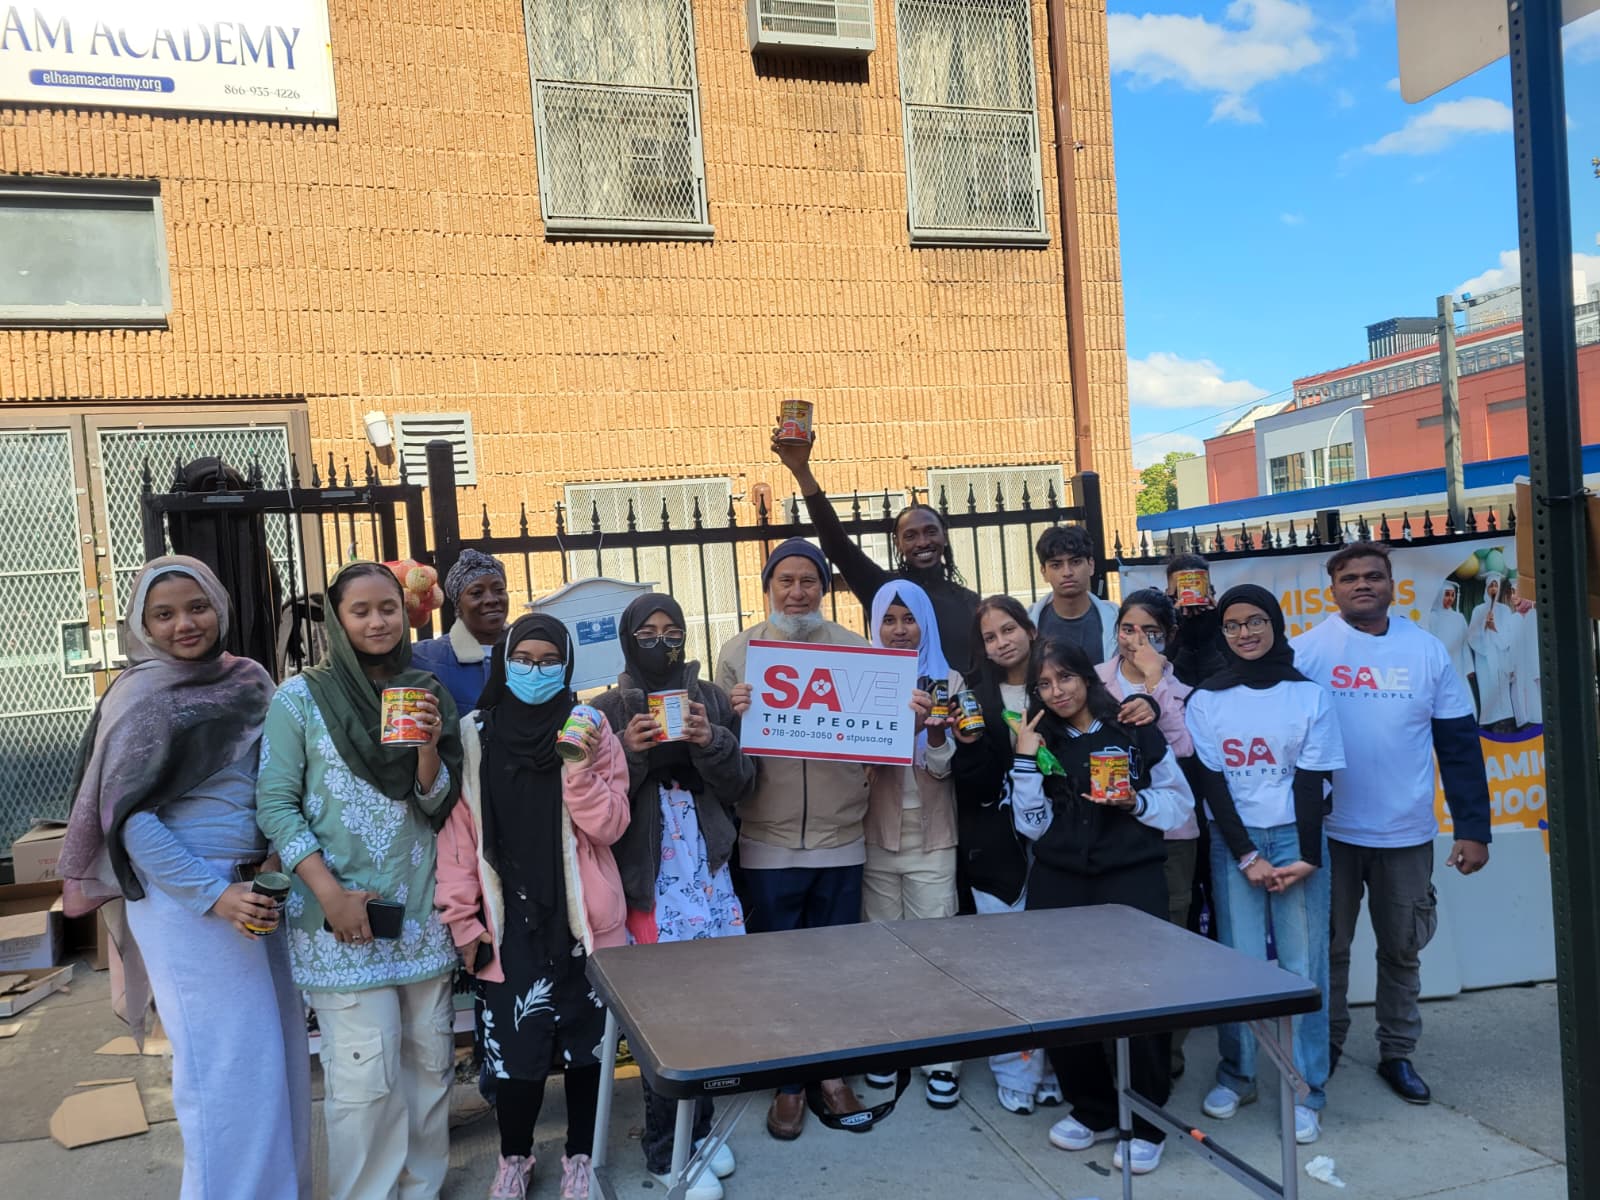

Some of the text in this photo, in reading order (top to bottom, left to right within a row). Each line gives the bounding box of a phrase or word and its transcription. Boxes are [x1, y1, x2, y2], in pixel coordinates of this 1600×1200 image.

[1, 5, 300, 70] AM ACADEMY
[43, 71, 162, 92] elhaamacademy.org
[1330, 665, 1409, 690] SAVE
[761, 665, 900, 716] SAVE
[763, 713, 898, 731] THE PEOPLE
[772, 729, 893, 745] 718-200-3050 stpusa.org
